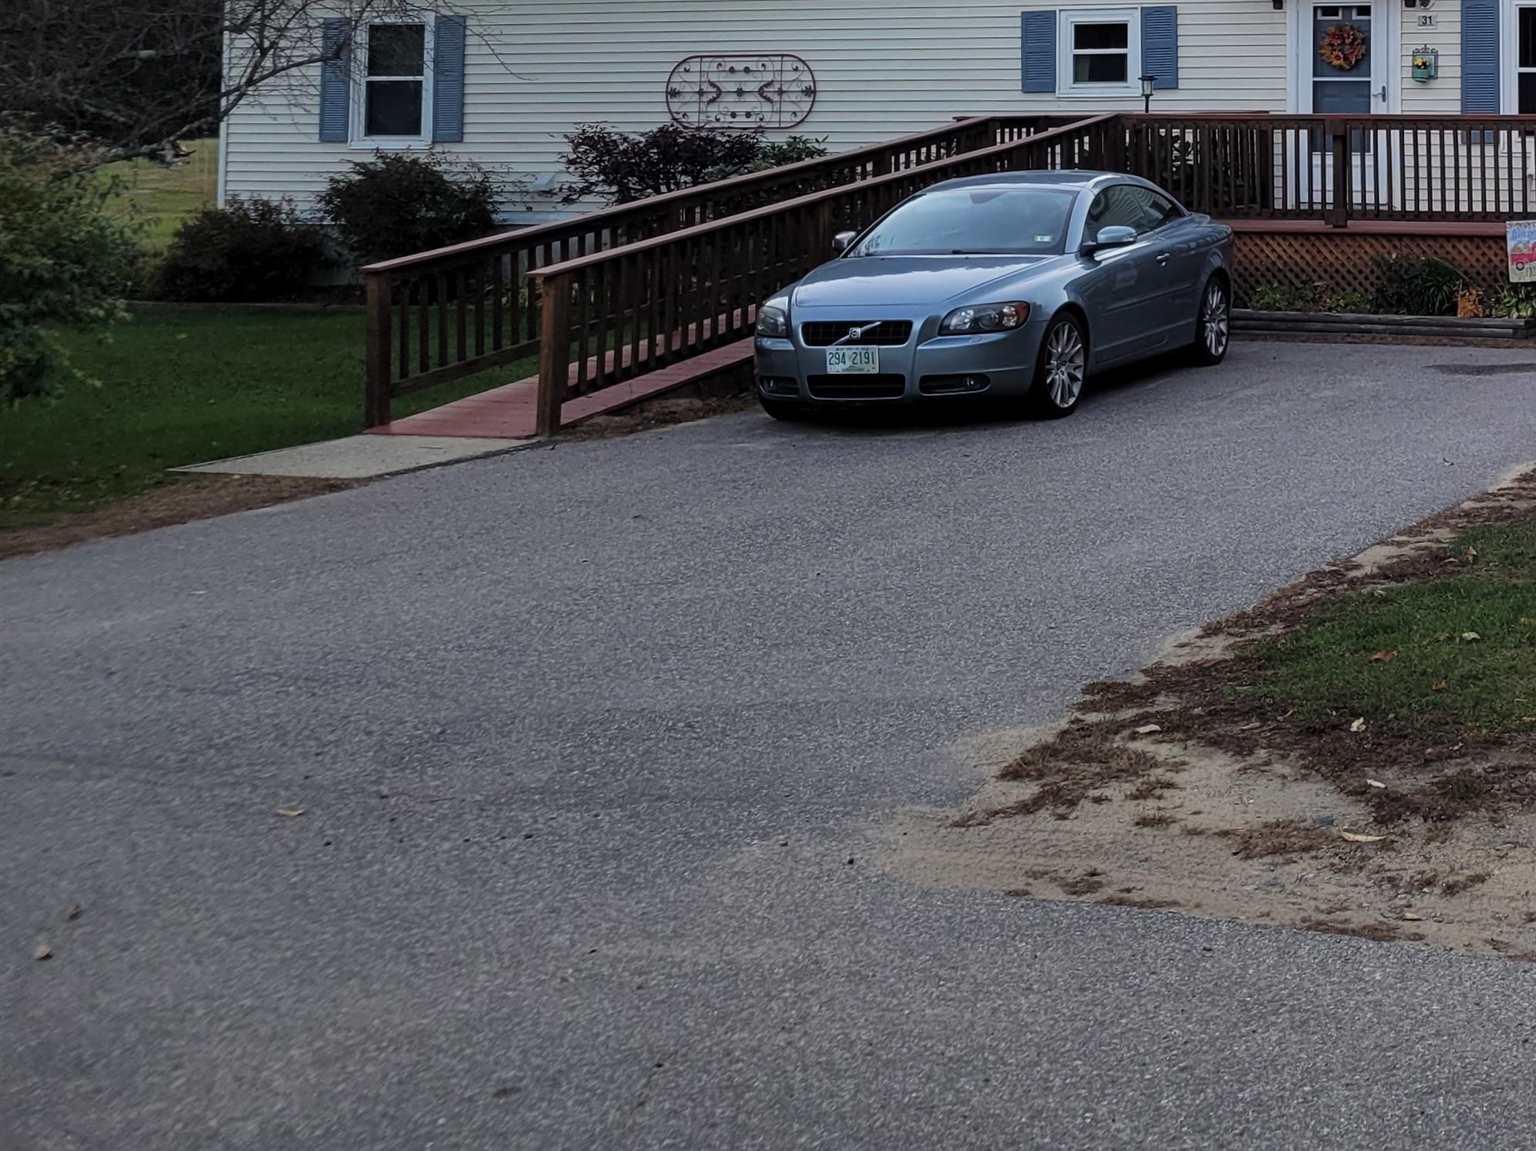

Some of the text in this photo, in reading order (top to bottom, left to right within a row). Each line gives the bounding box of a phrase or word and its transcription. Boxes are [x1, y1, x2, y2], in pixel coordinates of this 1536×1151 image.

[1422, 15, 1432, 25] 31
[828, 351, 875, 365] 294 2191
